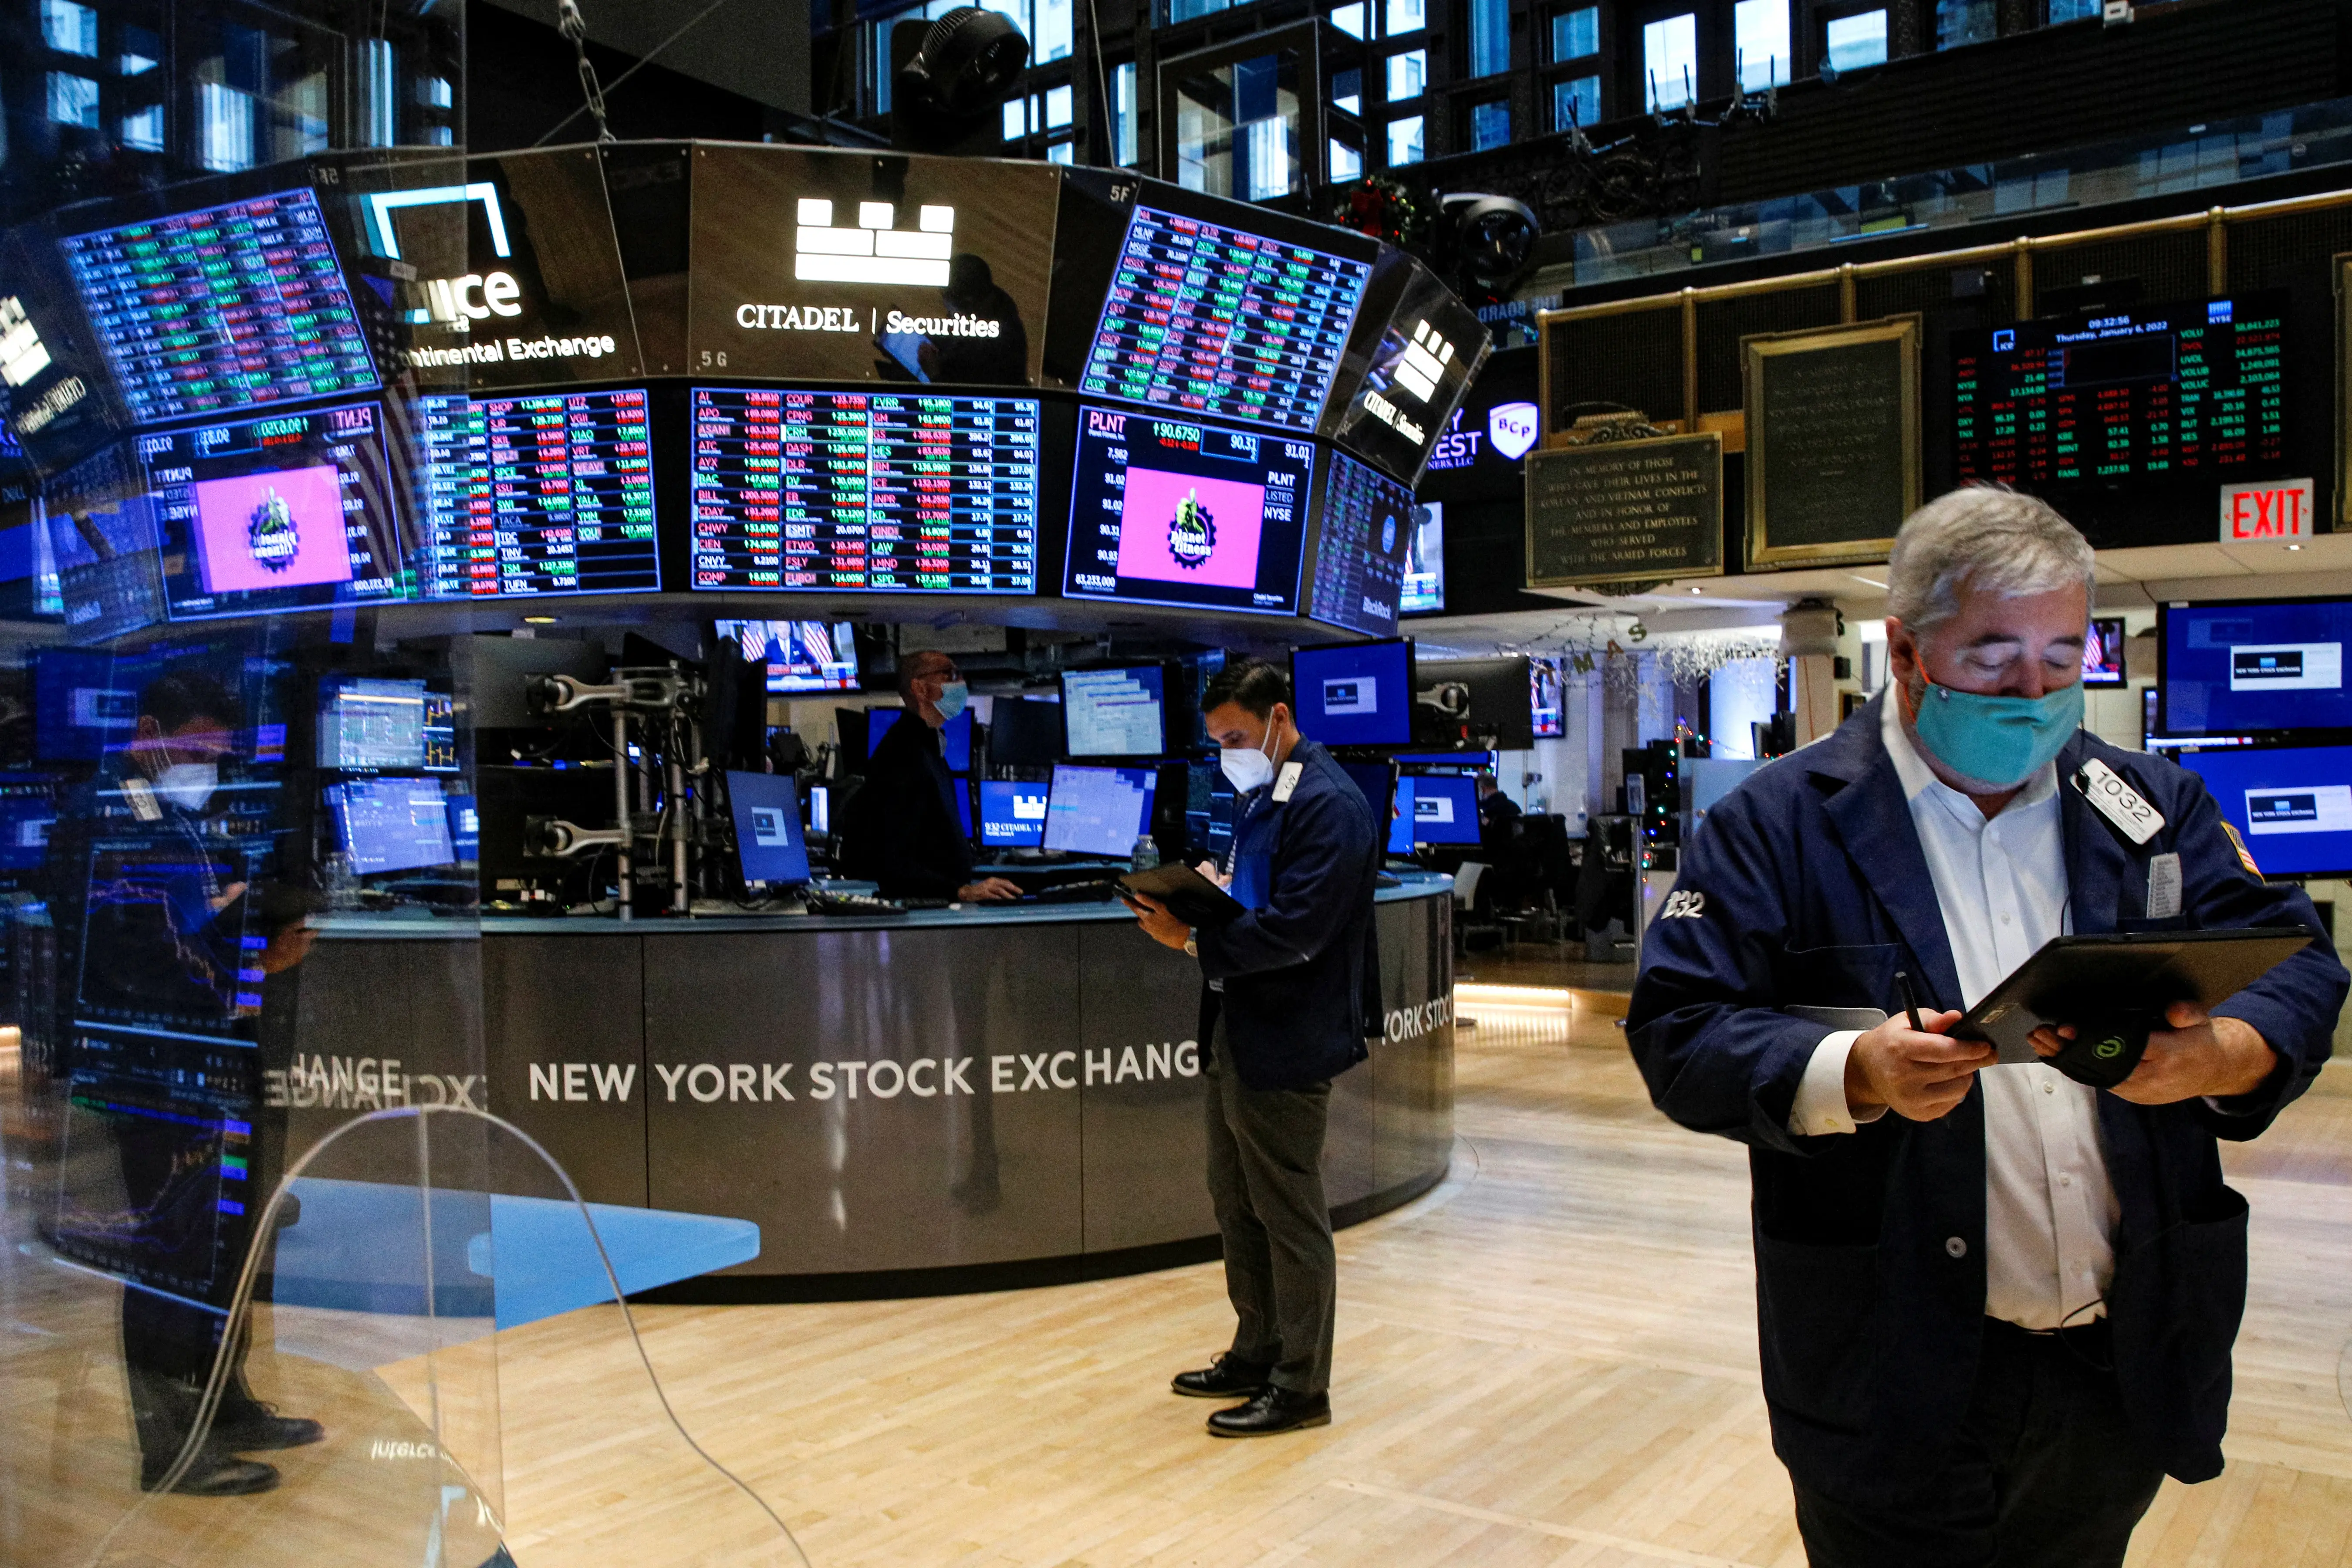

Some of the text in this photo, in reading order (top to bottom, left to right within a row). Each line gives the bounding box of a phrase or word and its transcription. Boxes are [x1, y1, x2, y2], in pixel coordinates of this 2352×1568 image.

[1109, 185, 1130, 203] 5F
[736, 303, 999, 338] CITADEL Securities
[2208, 314, 2232, 325] NYSE
[2055, 331, 2098, 343] Thursday,
[2099, 326, 2134, 338] January
[2145, 321, 2168, 332] 2022
[2180, 328, 2204, 339] VOLU
[410, 335, 615, 367] ntinental Exchange
[2180, 354, 2203, 365] UVOL
[1957, 380, 1978, 391] NYSE
[2180, 378, 2210, 391] VOLUC
[786, 394, 814, 405] COUR
[1957, 393, 1974, 403] NYA
[786, 410, 813, 421] CPNG
[787, 427, 807, 436] CRM
[1499, 417, 1531, 439] BCP
[1089, 411, 1310, 460] PLNT 90.6750 90.31 91.01
[699, 440, 718, 450] ATC
[786, 443, 813, 453] DASH
[1433, 431, 1483, 460] EST
[786, 459, 805, 469] DLR
[1268, 471, 1296, 487] PLNT
[2057, 468, 2080, 479] FANG
[786, 476, 800, 486] DV
[873, 477, 888, 487] ICE
[575, 494, 600, 505] YALA
[1266, 490, 1294, 504] LISTED
[1264, 506, 1292, 522] NYSE
[2232, 488, 2305, 539] EXIT
[699, 523, 728, 533] CHWY
[1170, 528, 1206, 544] planet
[699, 539, 721, 549] CIEN
[786, 540, 815, 551] ETWO
[872, 542, 894, 553] LAW
[1174, 541, 1212, 556] fitness
[698, 555, 725, 566] CNVY
[872, 558, 898, 568] LMND
[699, 572, 727, 582] COMP
[790, 666, 812, 675] NEWS
[2097, 770, 2151, 824] 1032
[529, 1040, 1199, 1102] NEW YORK STOCK EXCHANG
